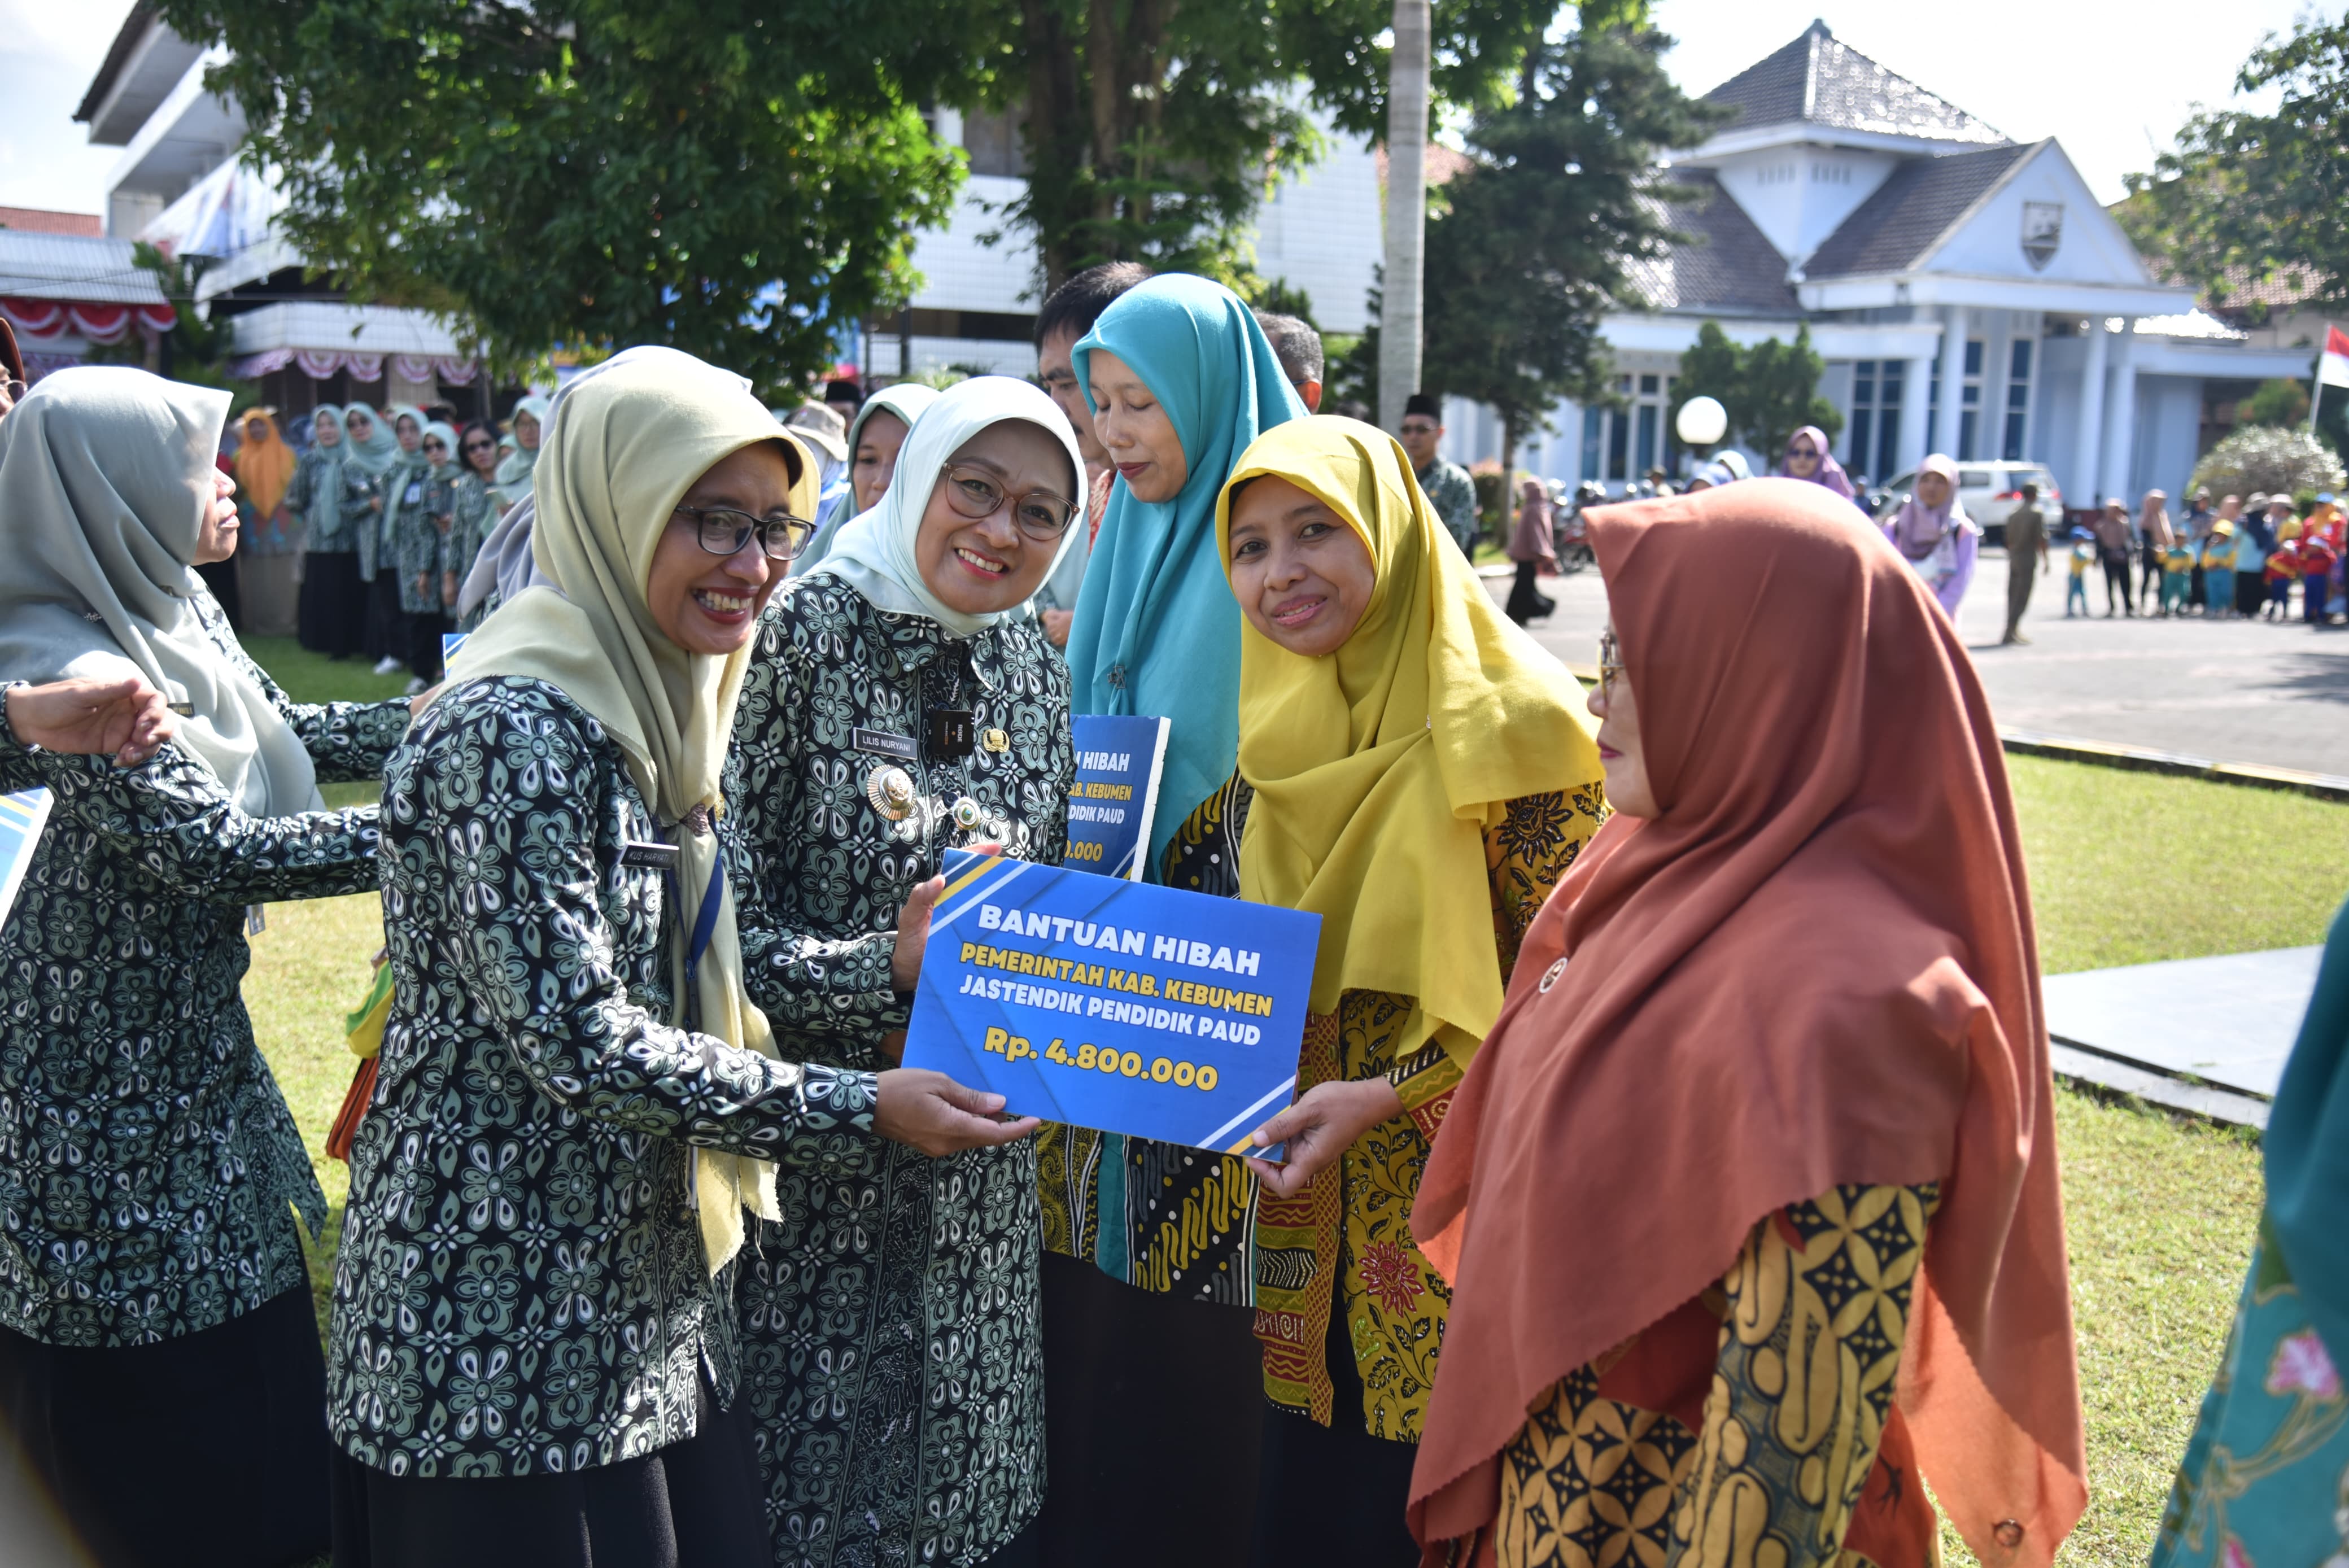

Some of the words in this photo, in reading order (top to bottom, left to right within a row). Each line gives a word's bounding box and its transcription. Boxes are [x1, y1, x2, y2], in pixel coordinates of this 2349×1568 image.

[862, 735, 879, 746] LILIS
[881, 739, 910, 752] NURYANI
[1082, 751, 1130, 772] HIBAH
[1068, 781, 1084, 797] AB.
[1085, 783, 1132, 801] KEBUMEN
[1068, 805, 1097, 822] DIDIK
[1097, 807, 1125, 824] PAUD
[628, 851, 643, 861] KUS
[644, 853, 670, 863] HARYATI
[978, 903, 1146, 958] BANTUAN
[1151, 934, 1261, 977] HIBAH
[960, 941, 1105, 987] PEMERINTAH
[1107, 968, 1160, 998] KAB.
[1164, 979, 1274, 1017] KEBUMEN
[959, 973, 1085, 1015] JASTENDIK
[1086, 997, 1195, 1035] PENDIDIK
[1197, 1016, 1261, 1046] PAUD
[983, 1025, 1039, 1063] Rp.
[1045, 1037, 1219, 1091] 4.800.000
